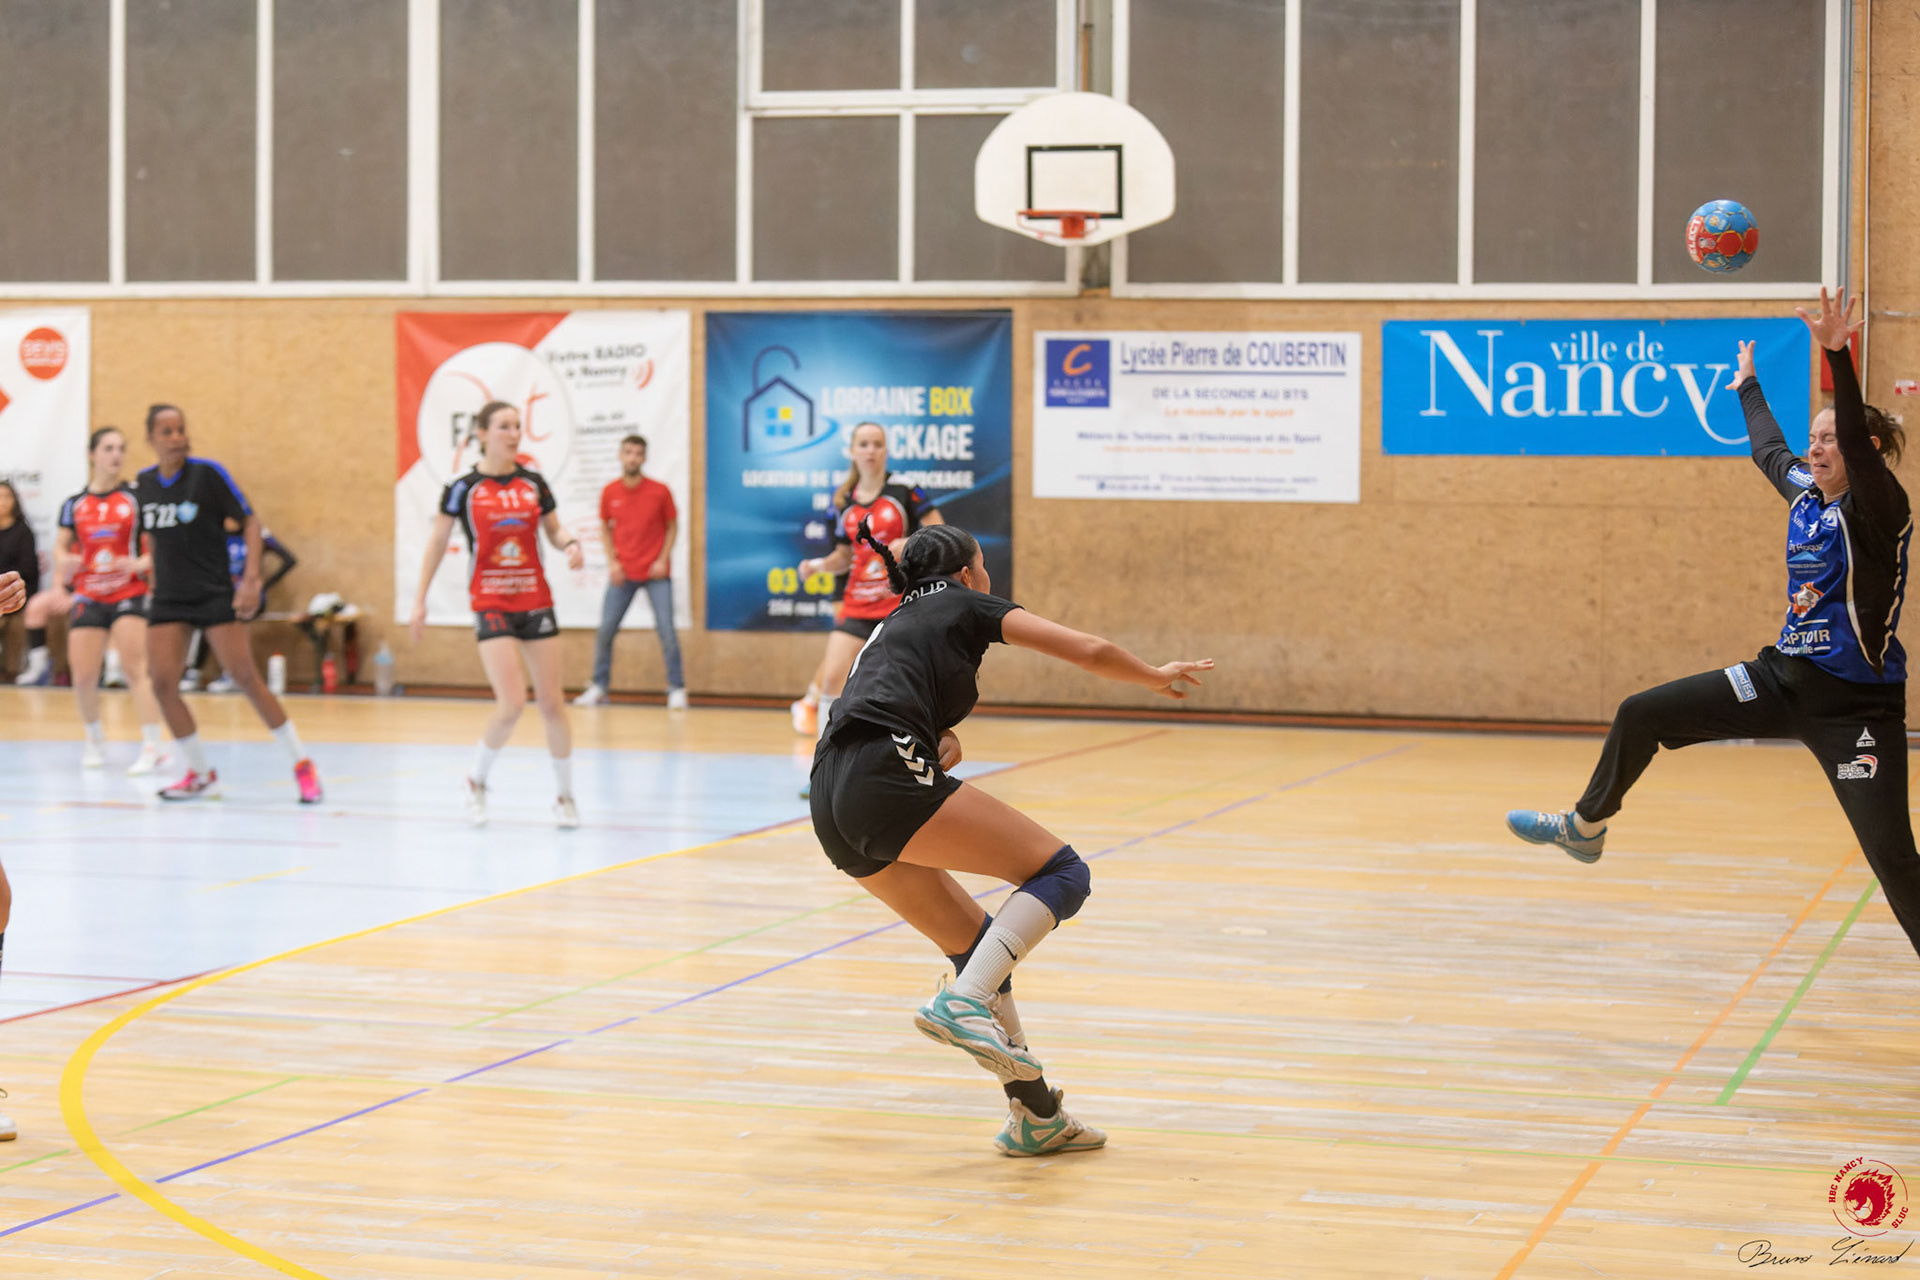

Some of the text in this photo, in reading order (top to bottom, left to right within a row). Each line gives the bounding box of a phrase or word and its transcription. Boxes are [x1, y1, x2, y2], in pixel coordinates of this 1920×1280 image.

[595, 345, 647, 360] RADIO
[1121, 341, 1346, 372] Lycée Pierre de COUBERTIN
[1551, 331, 1664, 362] ville de
[822, 386, 974, 416] LORRAINE BOX
[1152, 388, 1309, 400] DE LA SECONDE AU BTS
[1420, 330, 1770, 445] Nancy
[842, 424, 975, 460] SCKAGE
[497, 488, 520, 508] 11
[768, 567, 799, 595] 03
